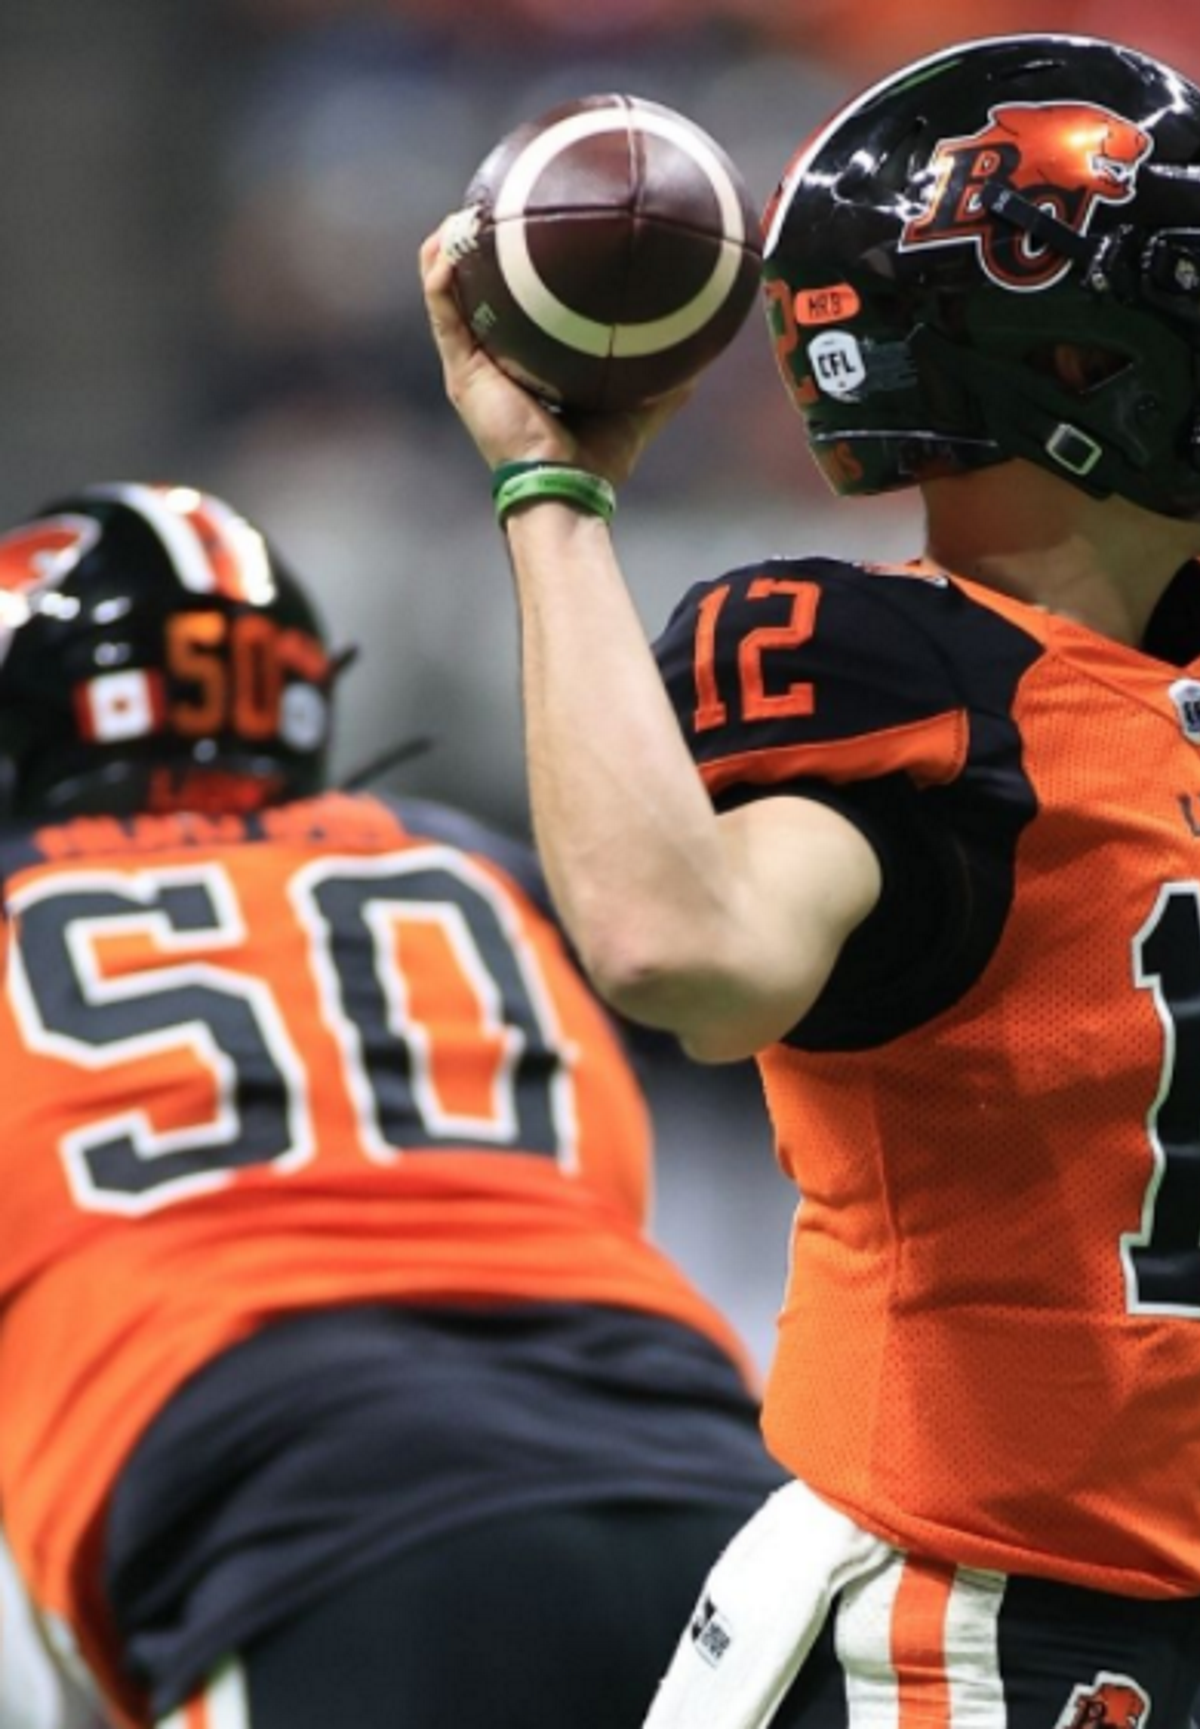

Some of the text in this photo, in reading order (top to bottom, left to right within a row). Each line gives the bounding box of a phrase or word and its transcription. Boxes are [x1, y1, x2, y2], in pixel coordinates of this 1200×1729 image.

[816, 349, 856, 380] CFL
[166, 611, 283, 740] 50
[694, 577, 820, 732] 12
[8, 847, 580, 1216] 50
